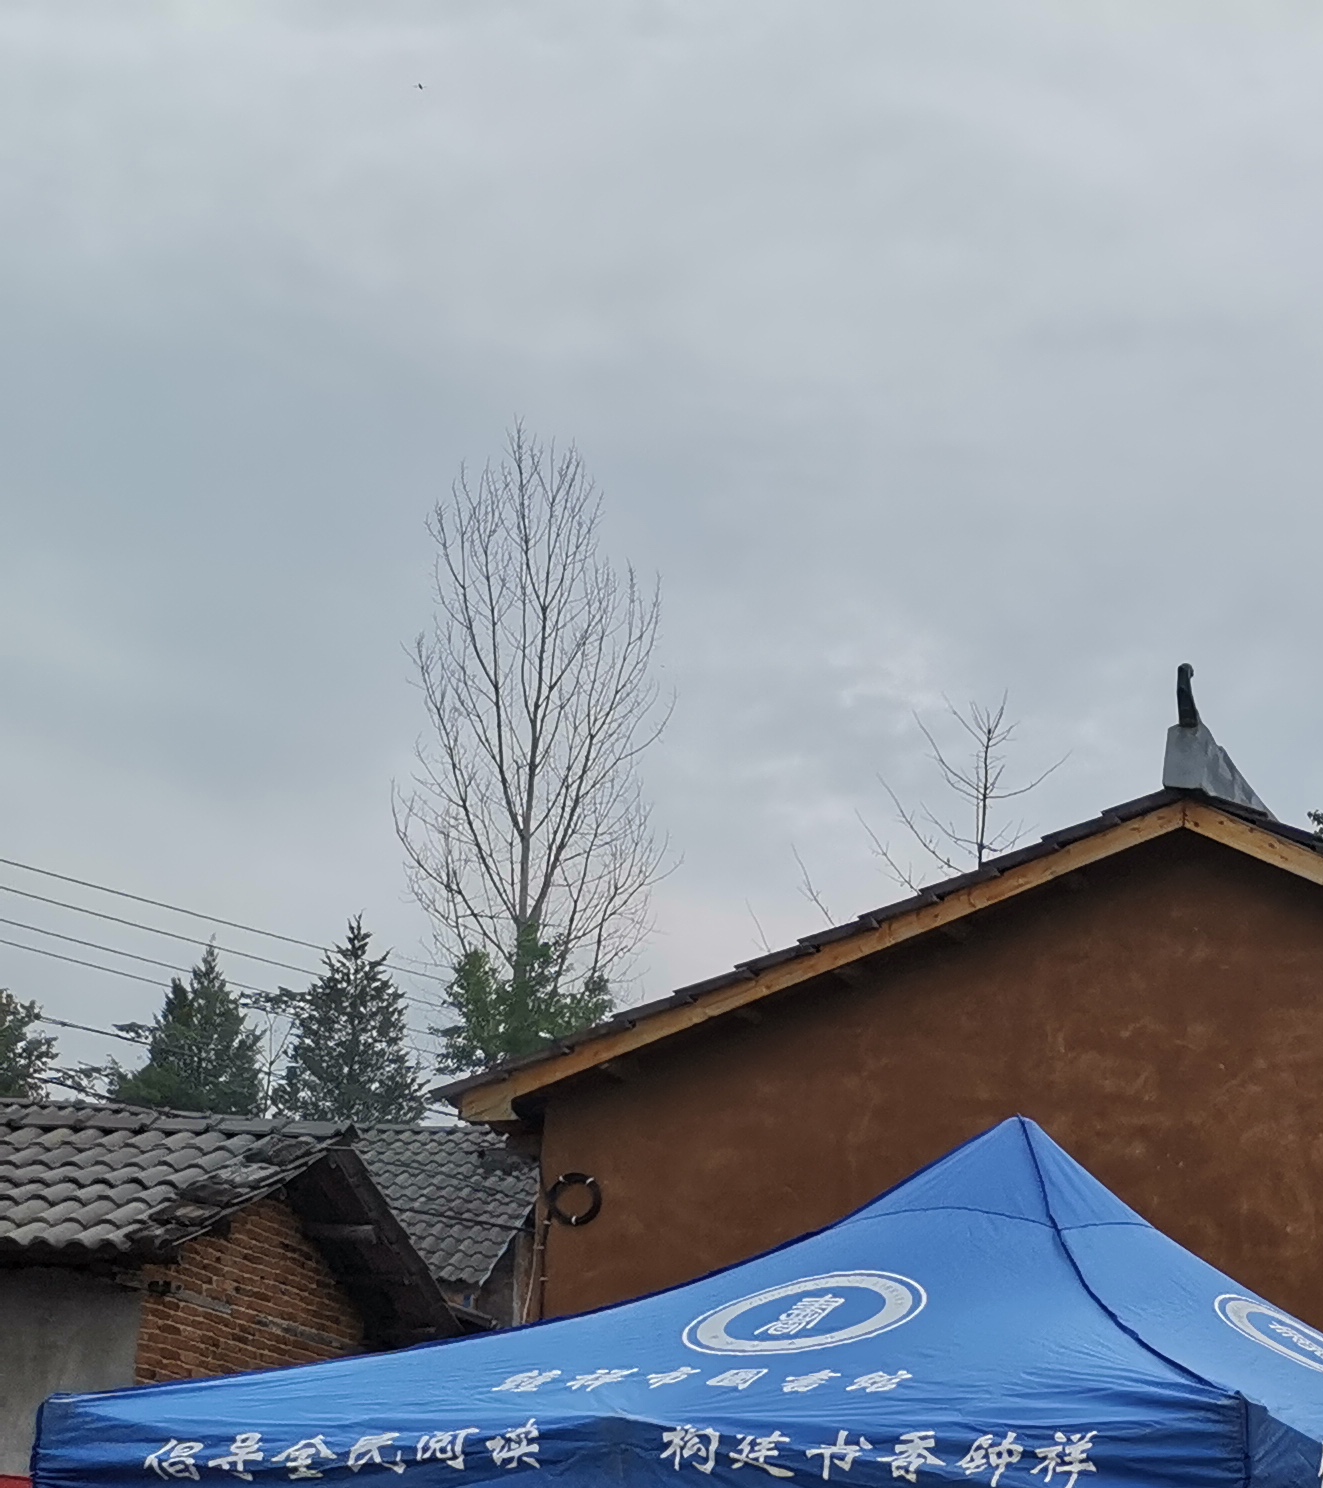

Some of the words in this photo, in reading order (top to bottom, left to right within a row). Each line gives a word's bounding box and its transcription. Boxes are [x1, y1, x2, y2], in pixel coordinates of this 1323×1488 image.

[144, 1418, 542, 1481] 倡导全民阅读
